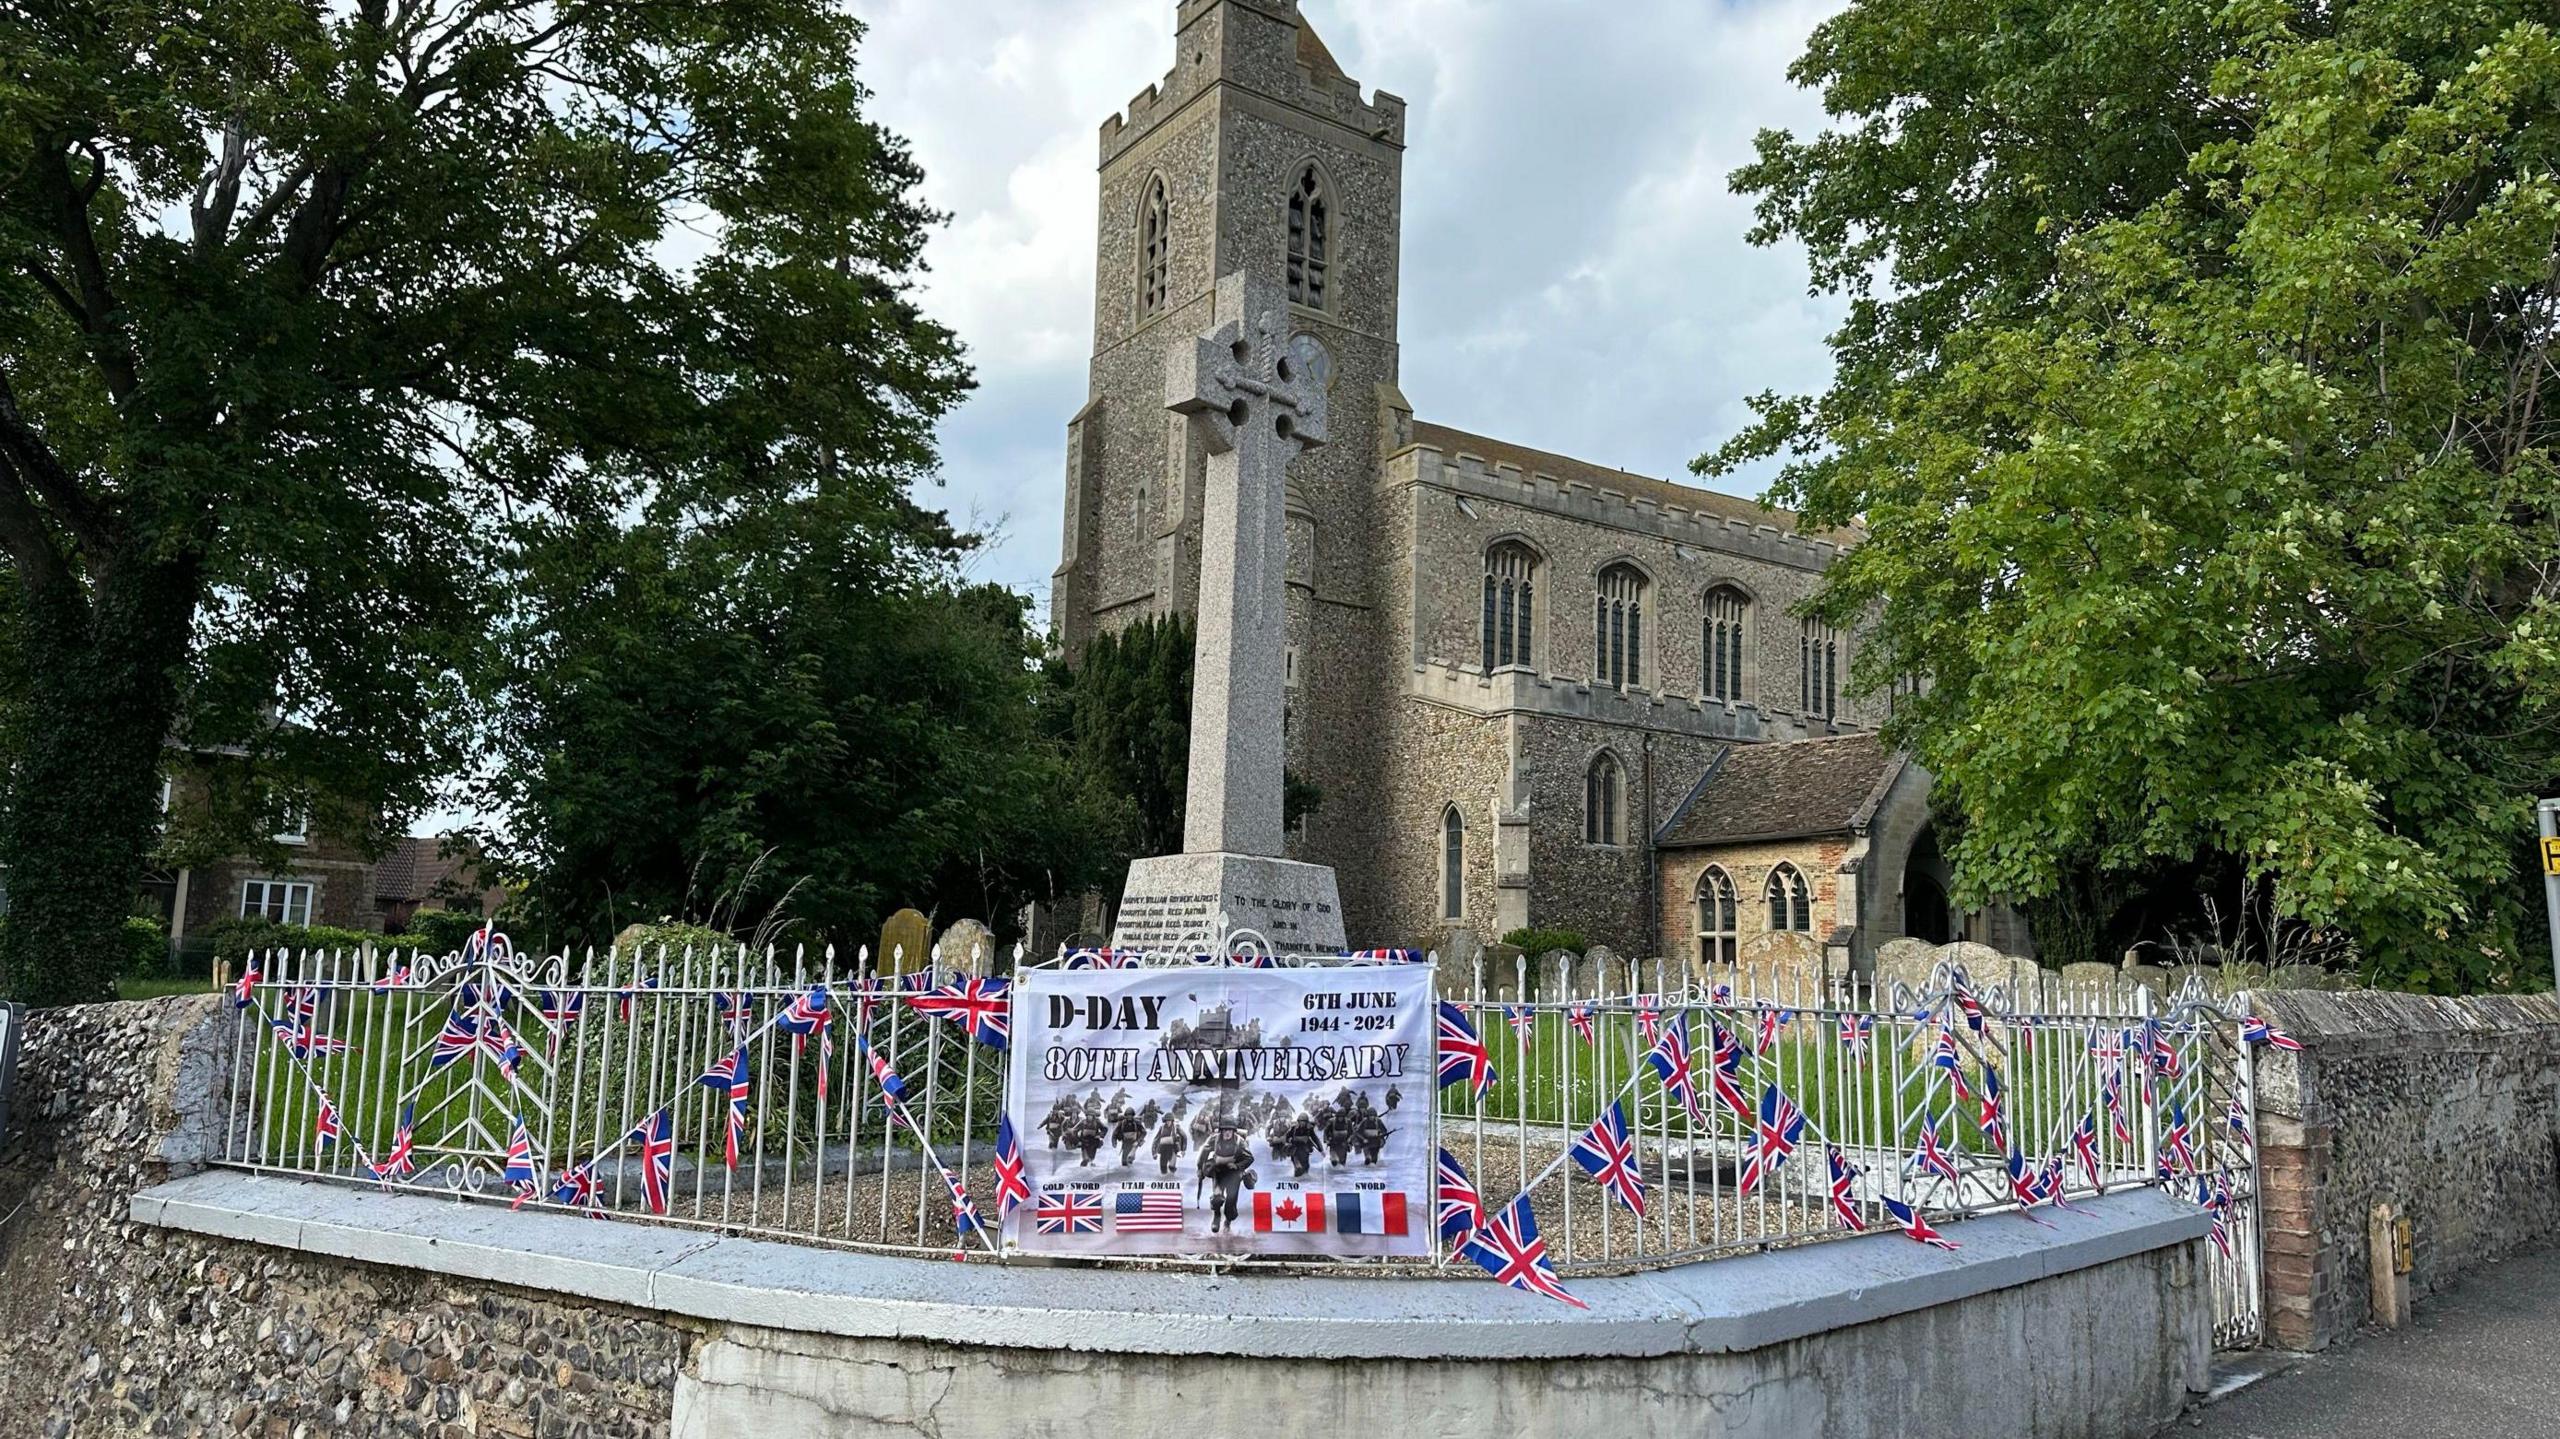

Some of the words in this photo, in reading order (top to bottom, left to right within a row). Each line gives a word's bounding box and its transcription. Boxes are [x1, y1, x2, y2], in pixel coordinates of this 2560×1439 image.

[1234, 895, 1245, 906] TO
[1251, 898, 1266, 908] THE
[1272, 899, 1297, 910] GLORY
[1302, 902, 1311, 911] OF
[1317, 903, 1331, 913] GOD
[1272, 921, 1287, 929] AND
[1290, 922, 1297, 930] IN
[1275, 941, 1312, 952] THANKFUL
[1316, 943, 1346, 953] MEMORY
[1303, 993, 1341, 1010] 6TH
[1346, 992, 1396, 1009] JUNE
[1048, 994, 1167, 1030] D-DAY
[1300, 1016, 1339, 1032] 1944
[1354, 1014, 1396, 1031] 2024
[1044, 1046, 1140, 1081] 80TH
[1147, 1043, 1409, 1081] ANNIVERSARY
[1043, 1183, 1064, 1191] GOLD
[1070, 1182, 1100, 1190] SWORD
[1121, 1182, 1145, 1190] UTAH
[1151, 1182, 1181, 1190] OMAHA
[1276, 1182, 1299, 1190] JUNO
[1355, 1182, 1386, 1190] SWORD
